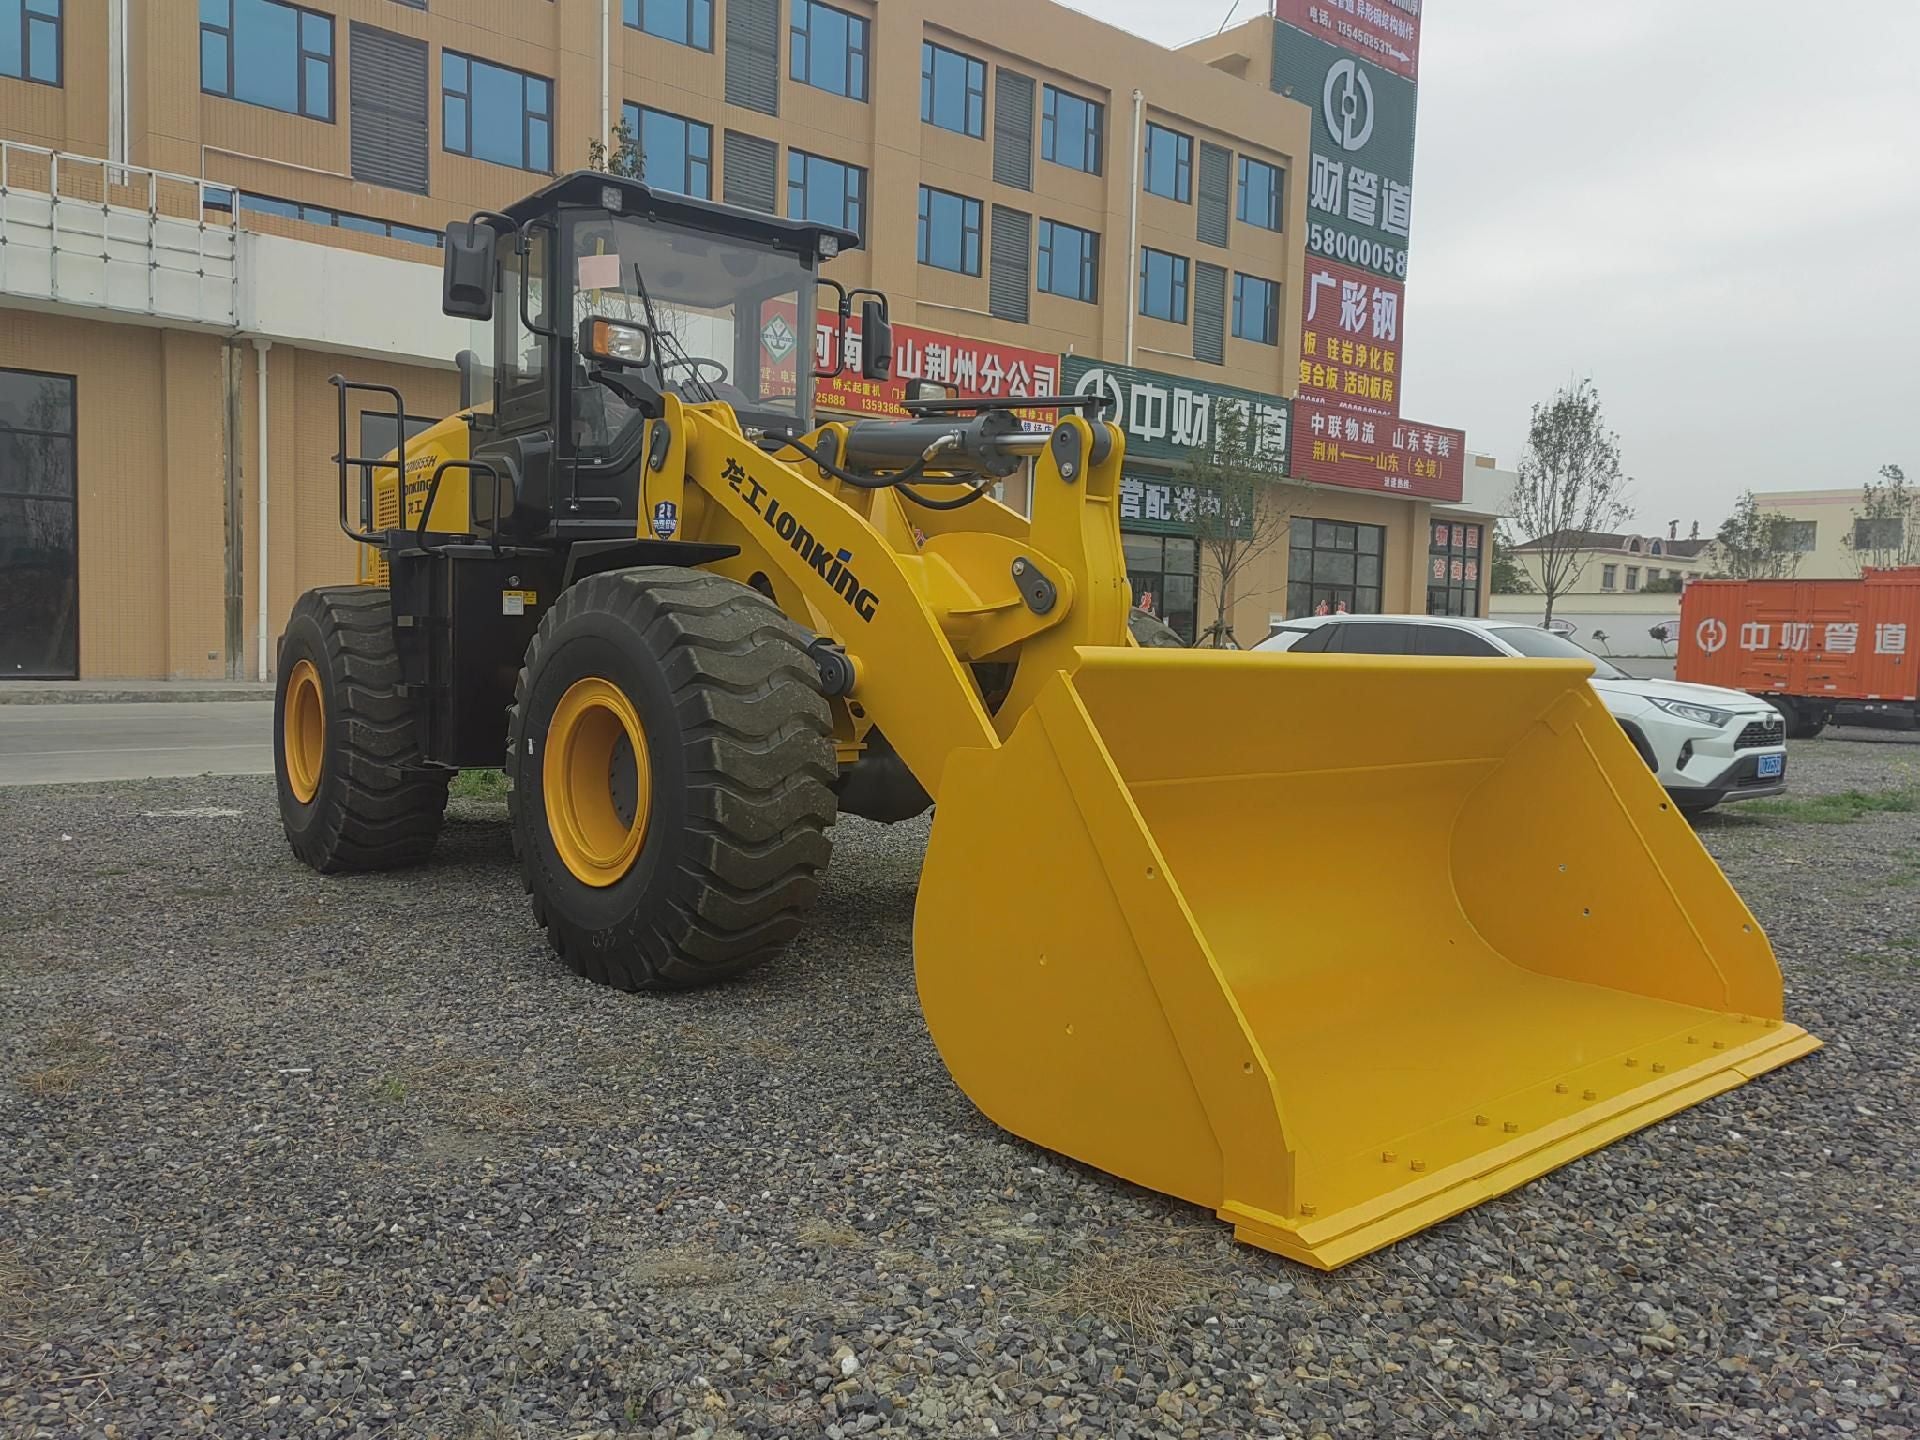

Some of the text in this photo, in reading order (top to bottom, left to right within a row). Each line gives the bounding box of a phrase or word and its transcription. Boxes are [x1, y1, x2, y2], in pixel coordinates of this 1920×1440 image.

[1311, 152, 1410, 237] 财管道
[1307, 271, 1397, 341] 广彩钢
[832, 377, 881, 398] 桥式起重机
[1344, 369, 1393, 402] 活动板房
[1311, 412, 1450, 458] 中联物流 山东专线
[1312, 440, 1339, 464] 荆州
[1376, 451, 1400, 472] 山东
[1740, 622, 1907, 655] 中财管道
